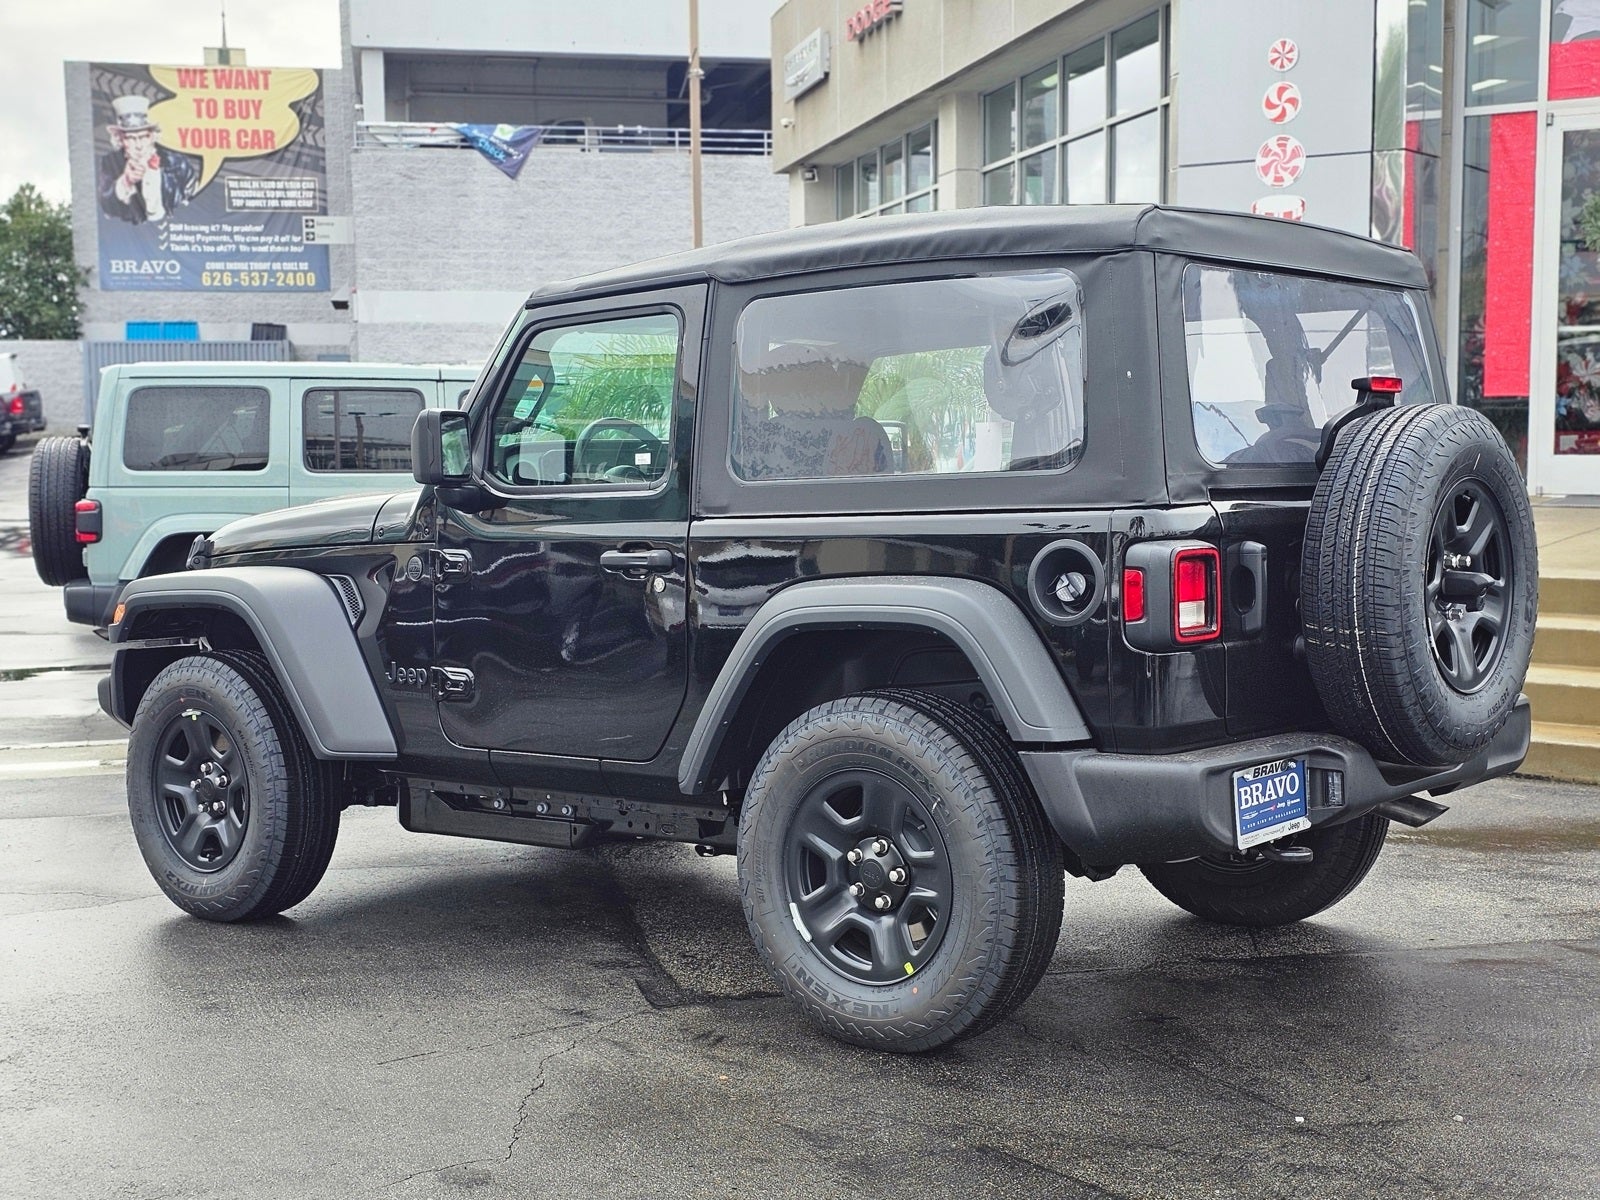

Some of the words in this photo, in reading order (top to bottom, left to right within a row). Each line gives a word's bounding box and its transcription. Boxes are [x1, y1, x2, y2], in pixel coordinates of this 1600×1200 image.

[177, 68, 209, 90] WE
[212, 69, 272, 91] WANT
[193, 98, 218, 119] TO
[223, 98, 262, 120] BUY
[178, 128, 231, 149] YOUR
[236, 129, 275, 149] CAR
[110, 260, 181, 274] BRAVO
[202, 271, 316, 286] 626-537-2400
[385, 661, 427, 689] Jeep
[1252, 759, 1289, 779] BRAVO
[1239, 772, 1300, 810] BRAVO
[1287, 820, 1301, 832] Jeep
[795, 969, 890, 1017] NEXEN
